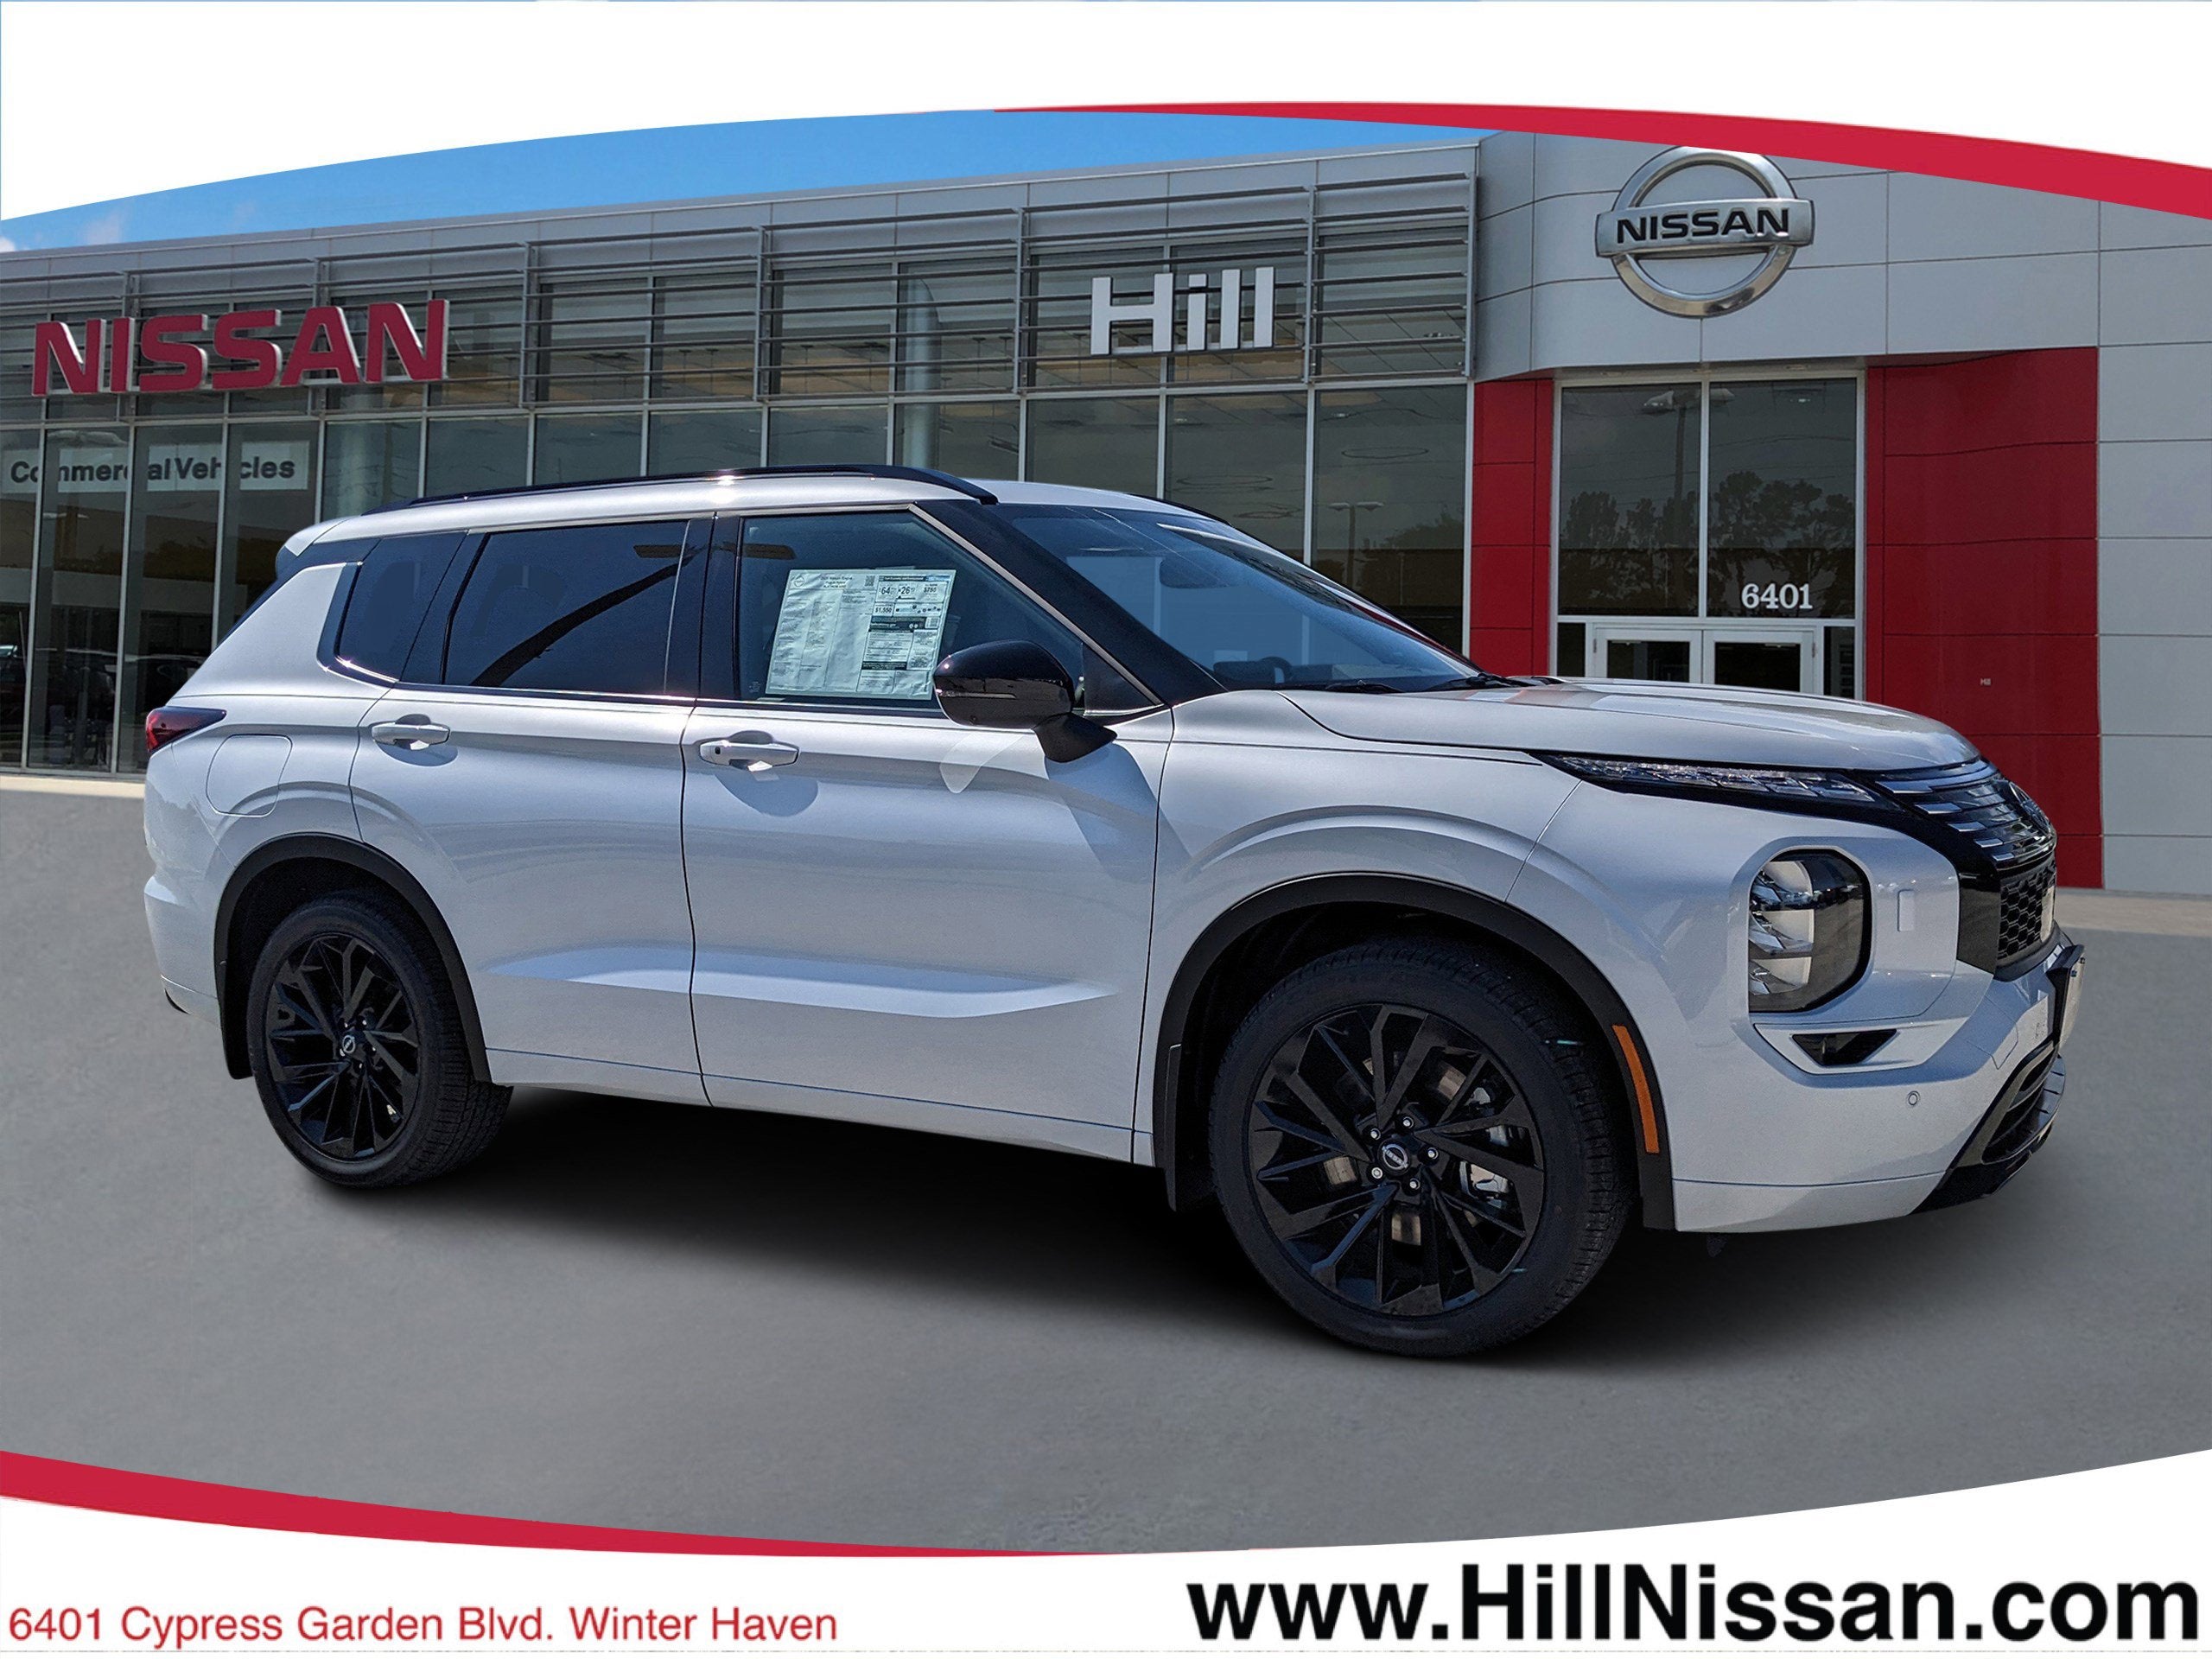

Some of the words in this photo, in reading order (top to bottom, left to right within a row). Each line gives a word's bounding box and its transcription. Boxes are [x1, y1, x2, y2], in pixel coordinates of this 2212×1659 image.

[1617, 208, 1789, 244] NISSAN
[1090, 266, 1274, 355] Hill
[33, 300, 448, 396] NISSAN
[175, 455, 296, 480] Vehcles
[1741, 583, 1813, 610] 6401
